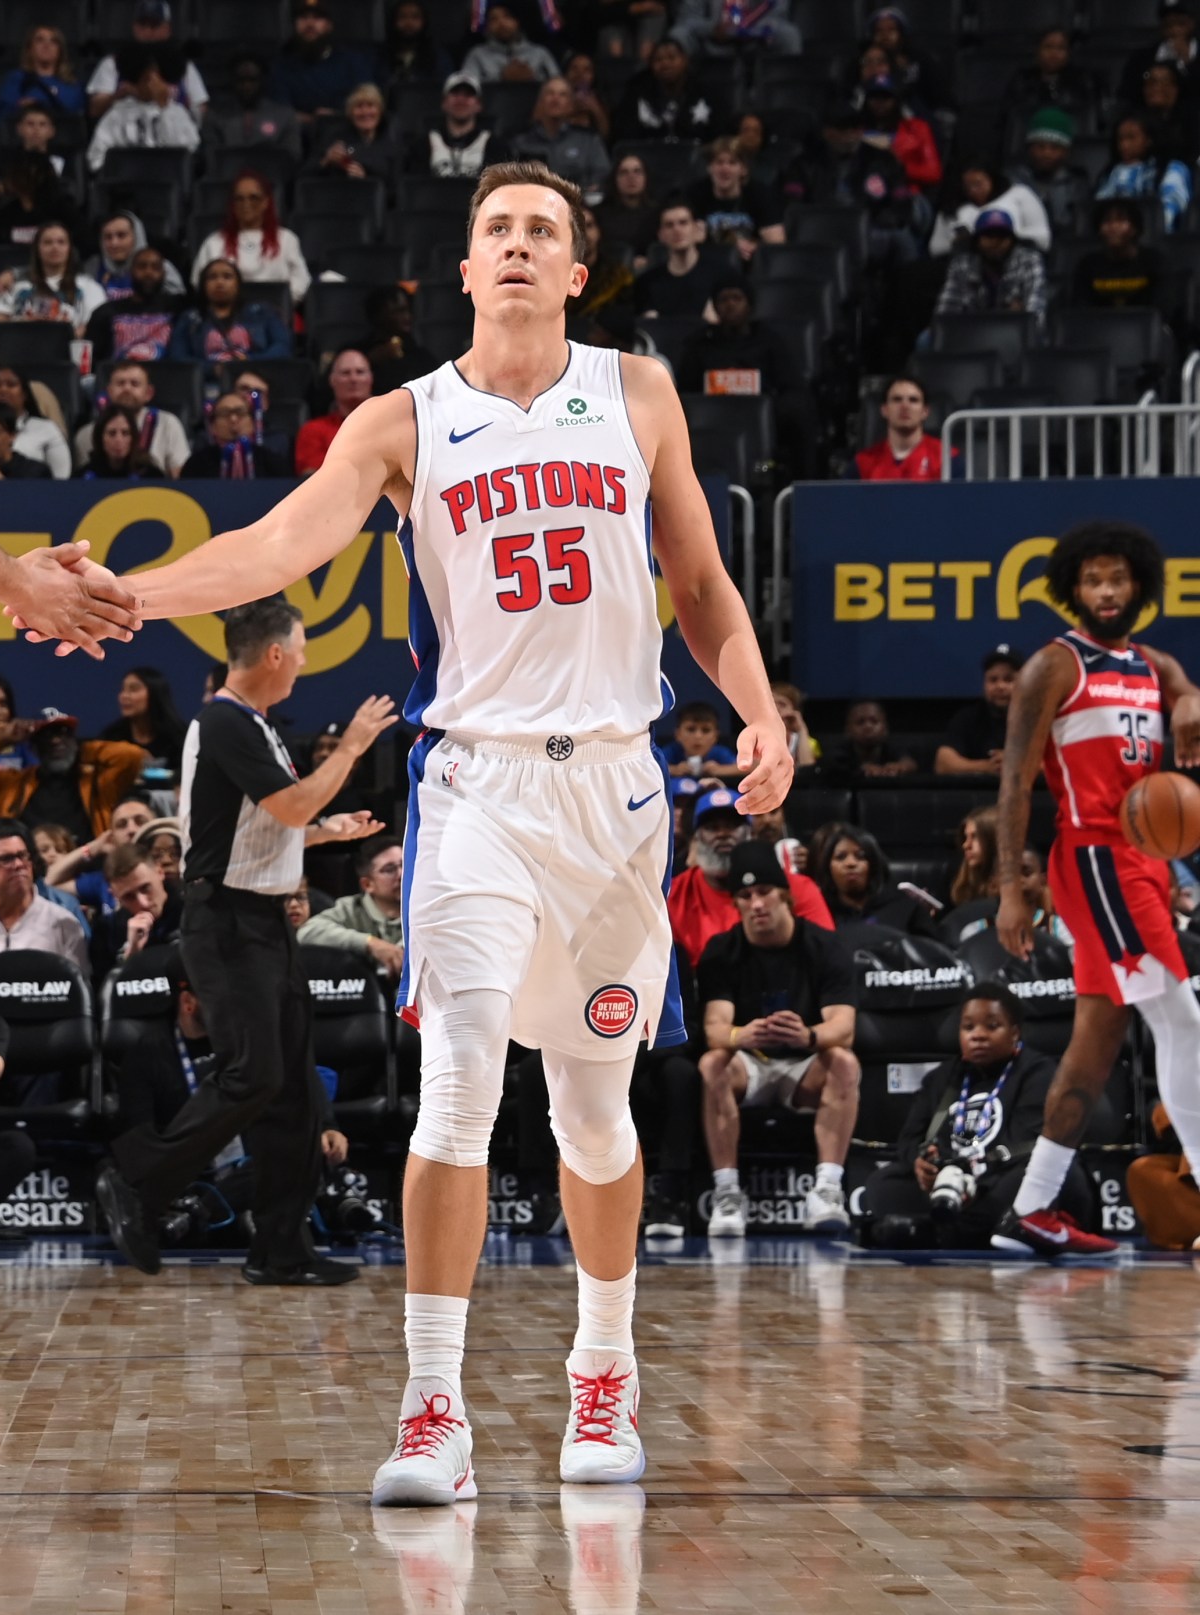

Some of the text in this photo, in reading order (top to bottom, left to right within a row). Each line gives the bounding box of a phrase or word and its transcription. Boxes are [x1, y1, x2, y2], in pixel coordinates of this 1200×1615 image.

[555, 414, 606, 427] StockX
[440, 461, 626, 535] PISTONS
[492, 526, 592, 612] 55
[1119, 712, 1154, 766] 35
[597, 1010, 629, 1020] PISTONS
[598, 1002, 629, 1011] DETROIT
